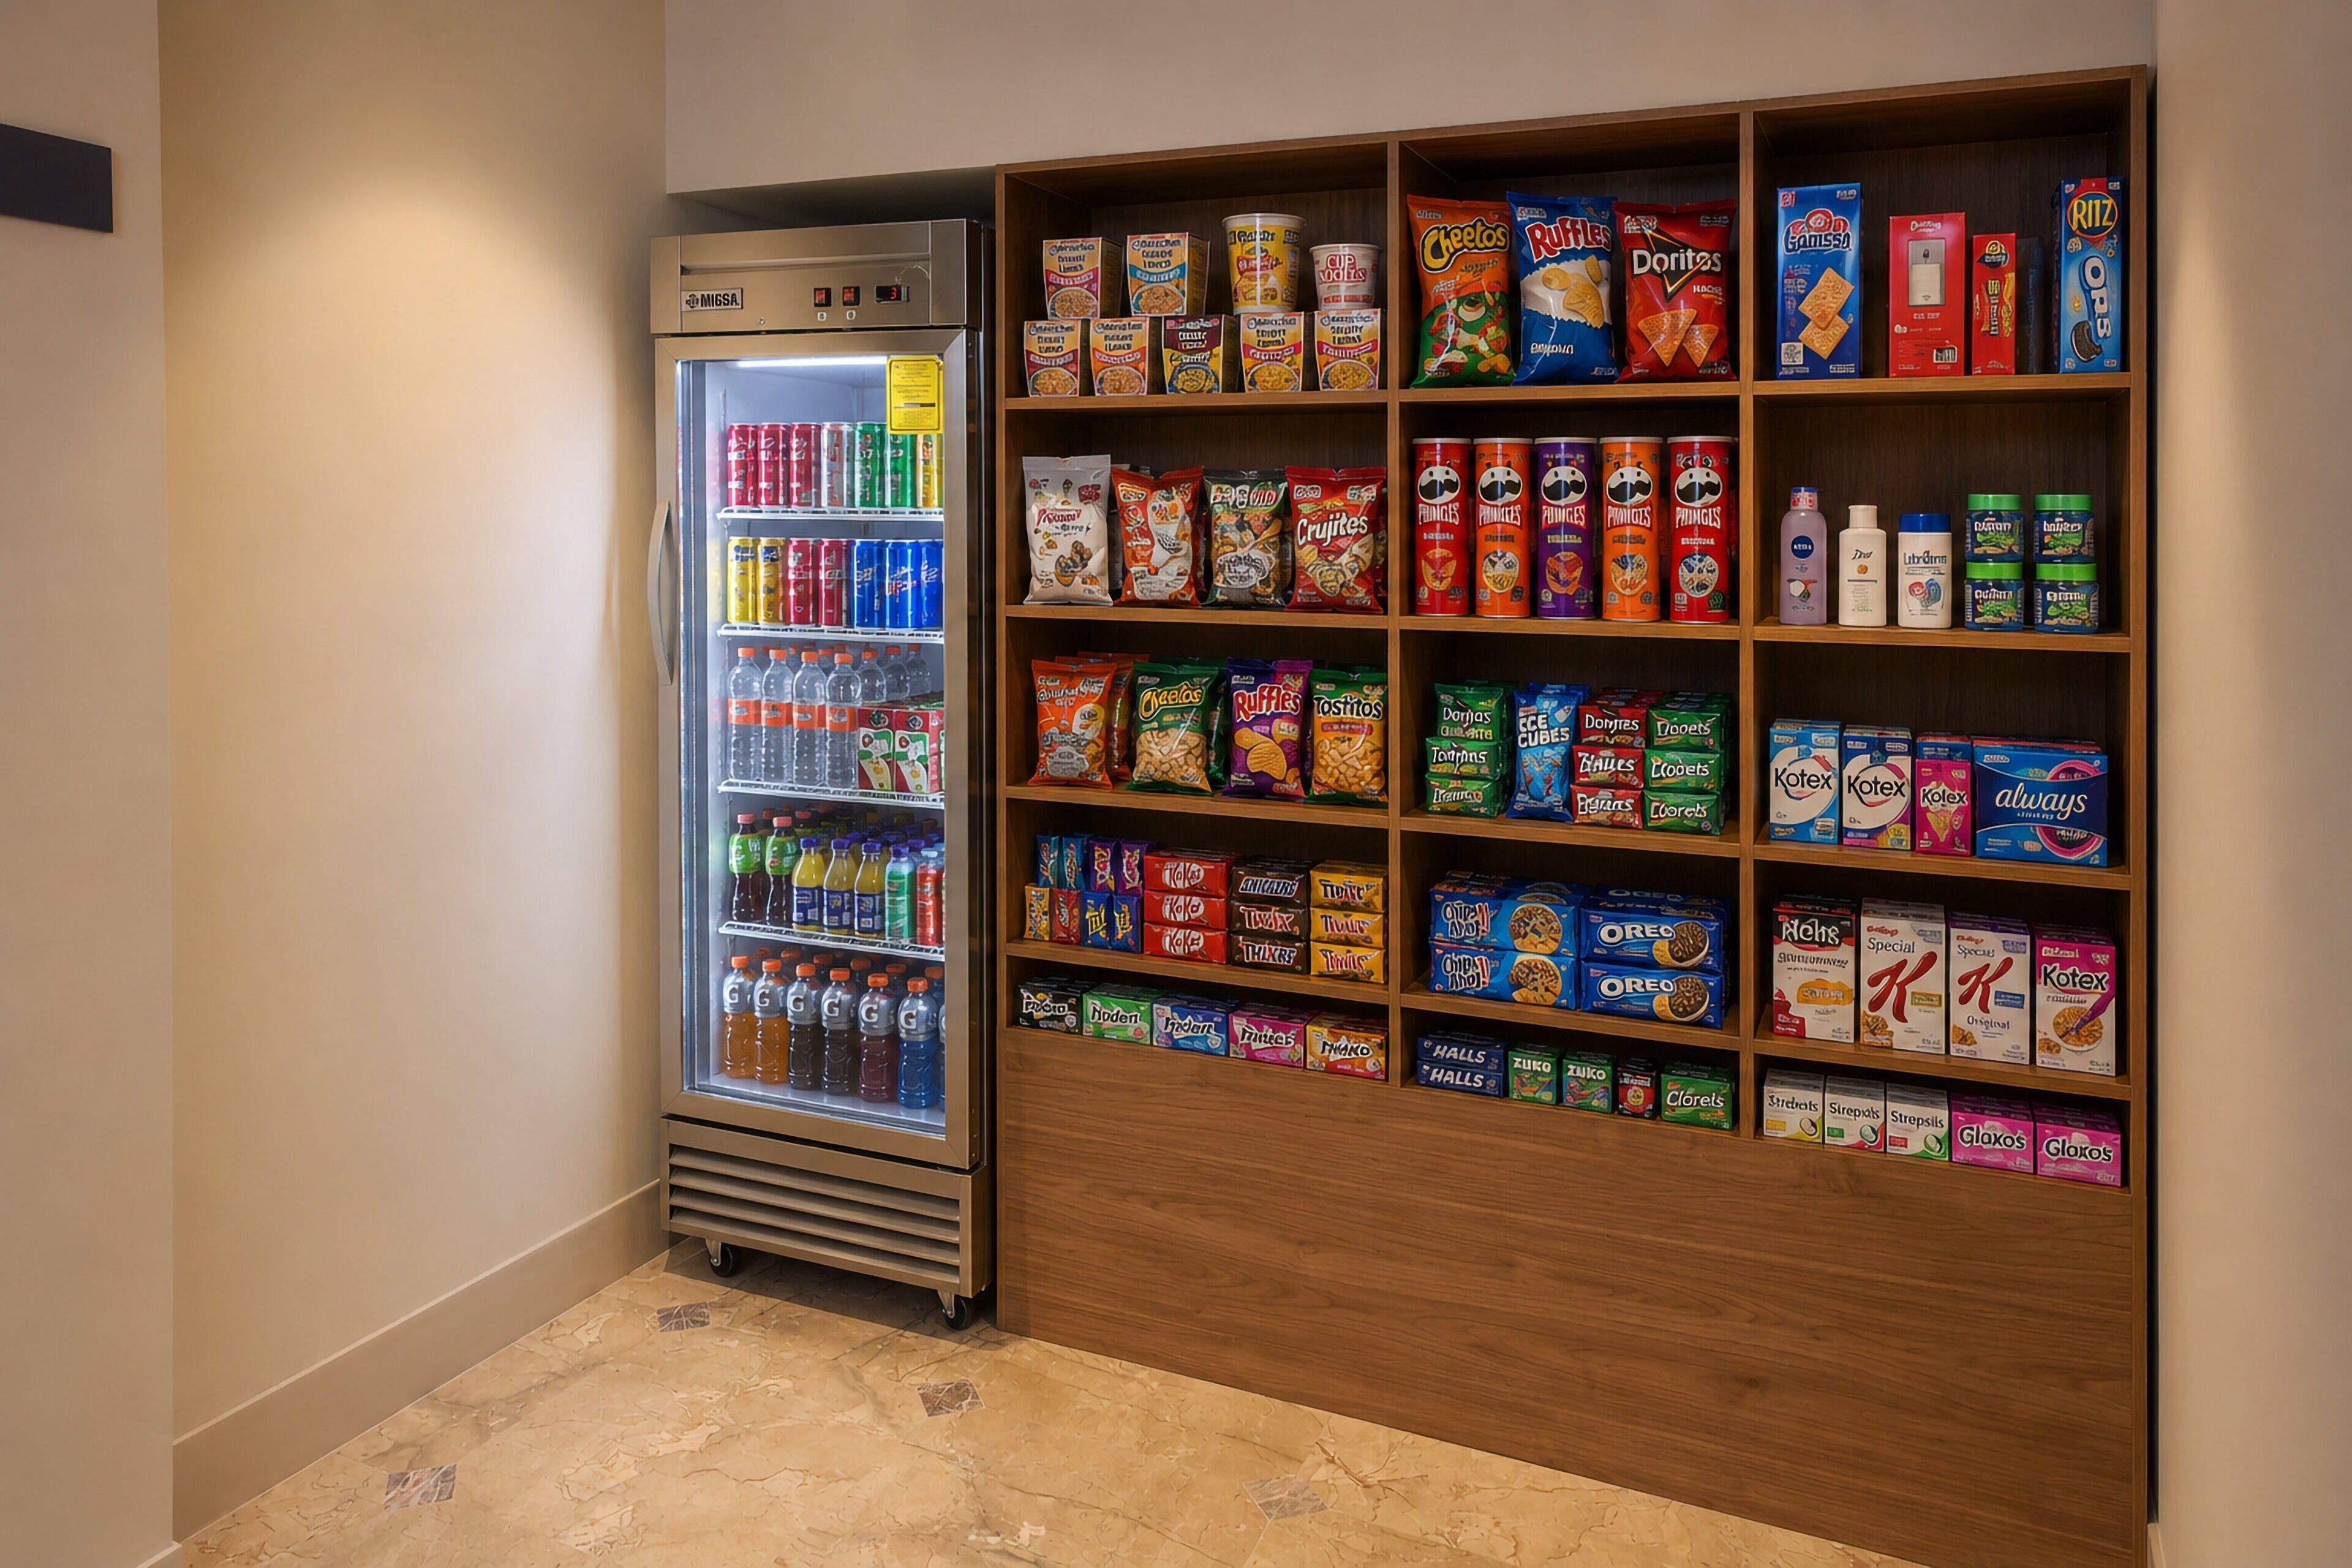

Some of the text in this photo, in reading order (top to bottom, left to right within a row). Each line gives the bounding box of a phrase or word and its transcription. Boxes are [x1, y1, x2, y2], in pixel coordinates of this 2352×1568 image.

[1422, 219, 1508, 271] Cheetos
[1633, 248, 1721, 274] Doritos
[700, 293, 739, 308] MIGSA
[1518, 728, 1570, 748] CUBES
[1774, 767, 1833, 790] Kotex
[1847, 775, 1905, 797] Kotex
[1996, 782, 2087, 820] always
[1600, 924, 1673, 943] OREO
[1868, 937, 1915, 954] Special
[1600, 978, 1673, 997] OREO
[1868, 951, 1937, 1023] K
[1958, 957, 2013, 1014] K
[2043, 965, 2108, 991] Kotex
[726, 984, 739, 1003] G
[756, 989, 770, 1007] G
[790, 995, 804, 1012] G
[824, 998, 839, 1017] G
[861, 1004, 878, 1023] G
[900, 1010, 916, 1029] G
[1433, 1045, 1486, 1063] HALLS
[1513, 1057, 1551, 1072] ZUKO
[1430, 1068, 1484, 1087] HALLS
